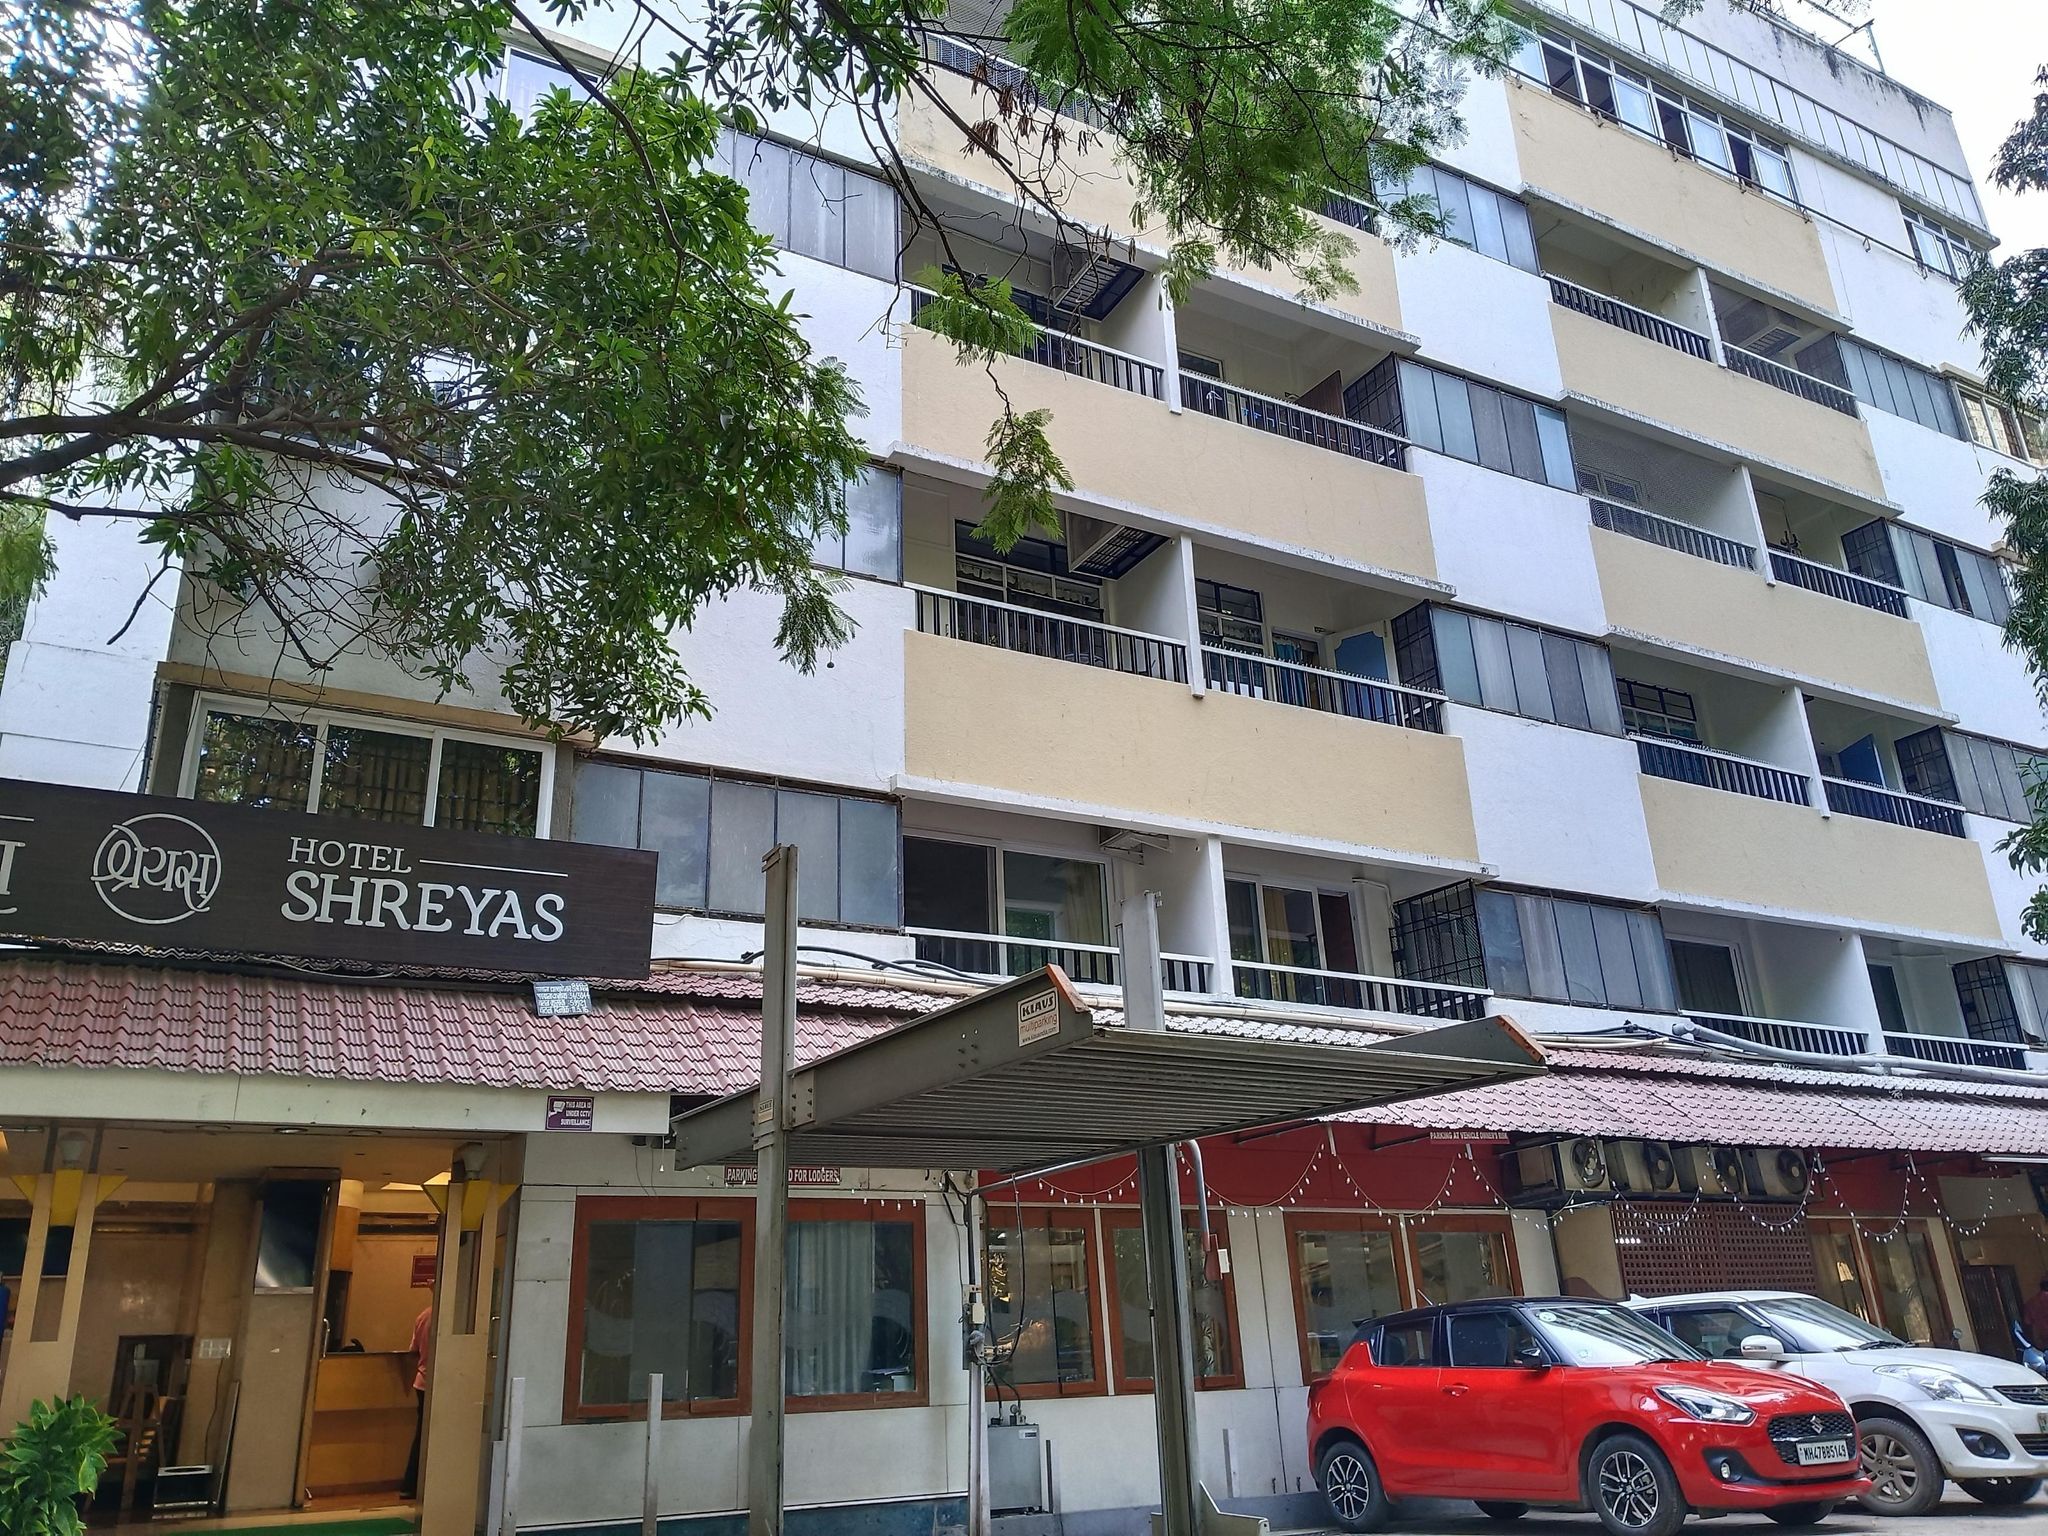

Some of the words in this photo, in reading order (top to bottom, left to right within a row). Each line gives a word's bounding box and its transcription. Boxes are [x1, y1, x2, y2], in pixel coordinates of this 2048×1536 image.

[287, 836, 412, 874] HOTEL
[281, 870, 565, 942] SHREYAS
[1022, 996, 1054, 1017] KLAUS
[561, 1118, 591, 1126] SURVEILLANCE
[1430, 1131, 1452, 1140] PARKING
[1460, 1131, 1479, 1140] VEHICLE
[727, 1168, 757, 1181] PARKING
[794, 1169, 807, 1182] FOR
[808, 1169, 839, 1183] LODGERS
